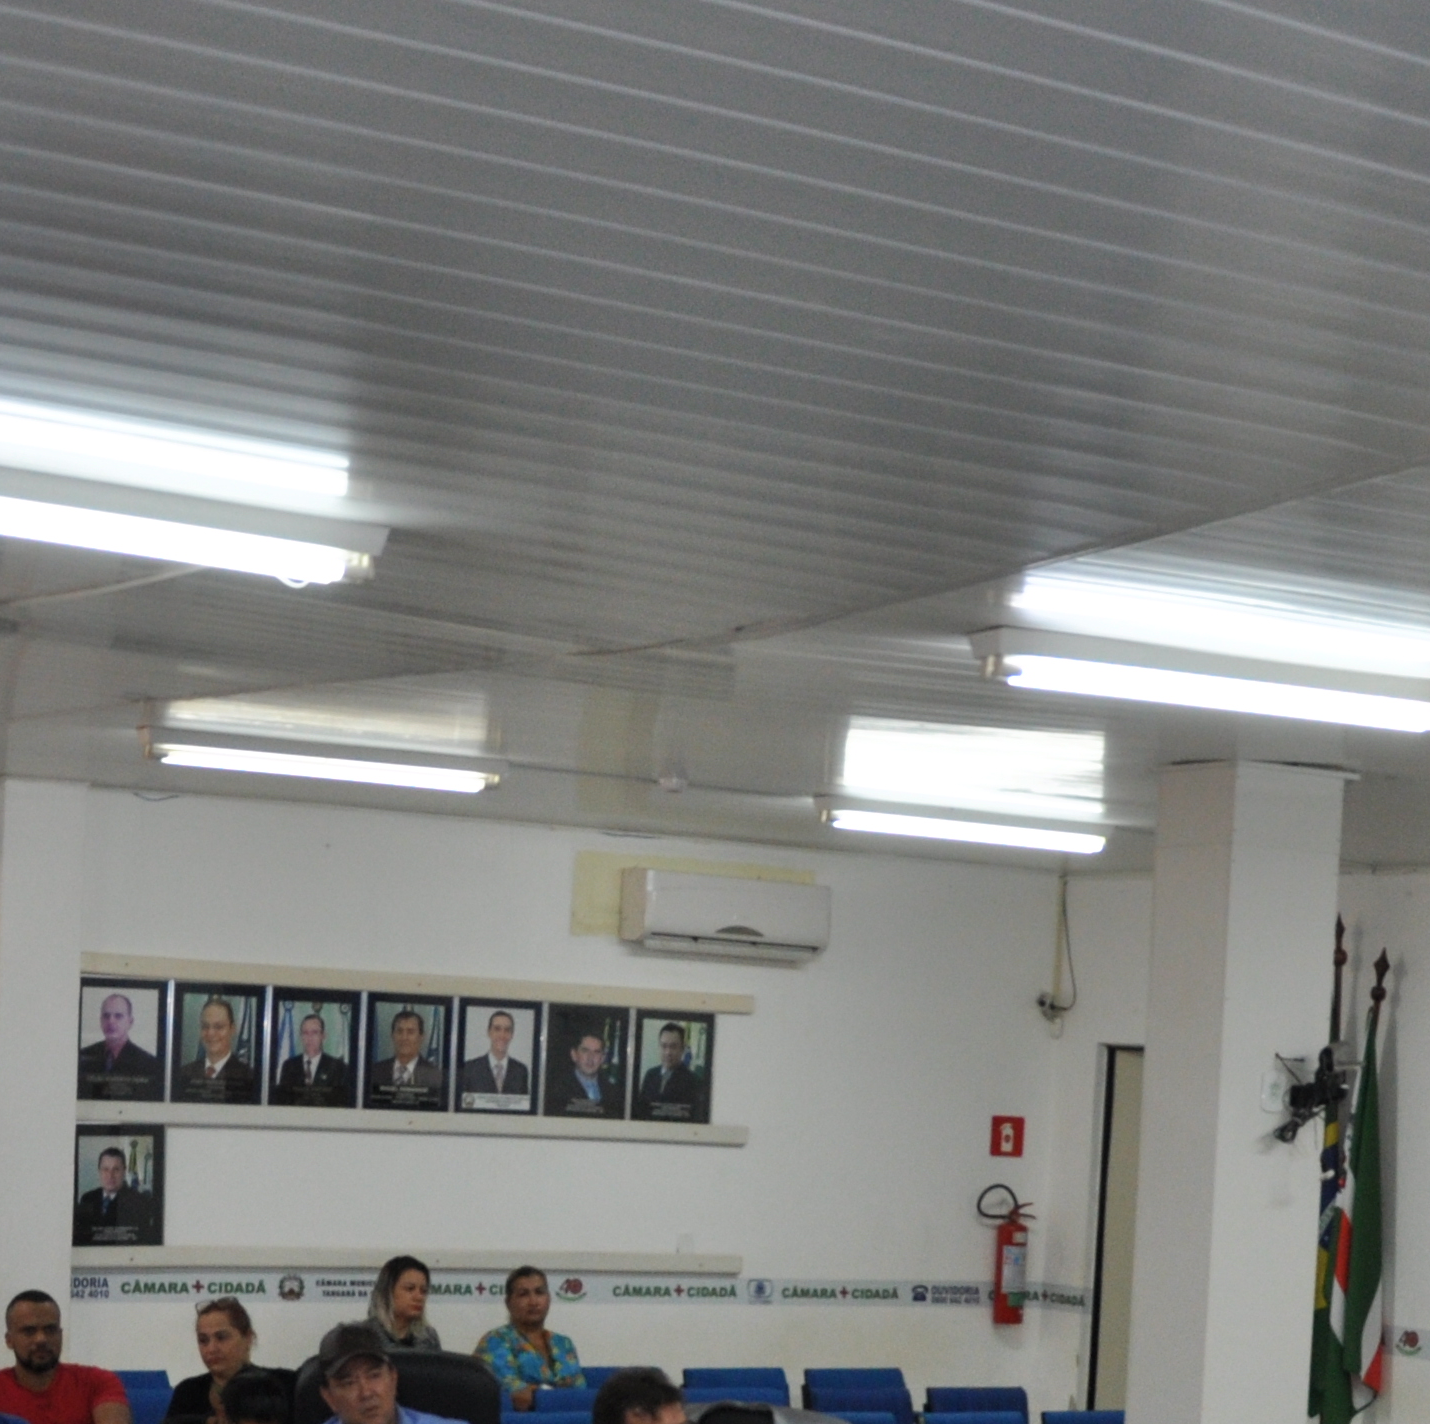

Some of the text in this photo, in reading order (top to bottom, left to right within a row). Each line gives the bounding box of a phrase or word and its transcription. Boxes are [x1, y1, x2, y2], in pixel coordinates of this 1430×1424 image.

[121, 1278, 189, 1295] CÂMARA
[207, 1280, 266, 1296] CIDADÃ
[612, 1283, 671, 1298] CÂMARA
[687, 1284, 737, 1299] CIDADÃ
[781, 1286, 837, 1300] CÂMARA
[851, 1286, 899, 1300] CIDADÃ
